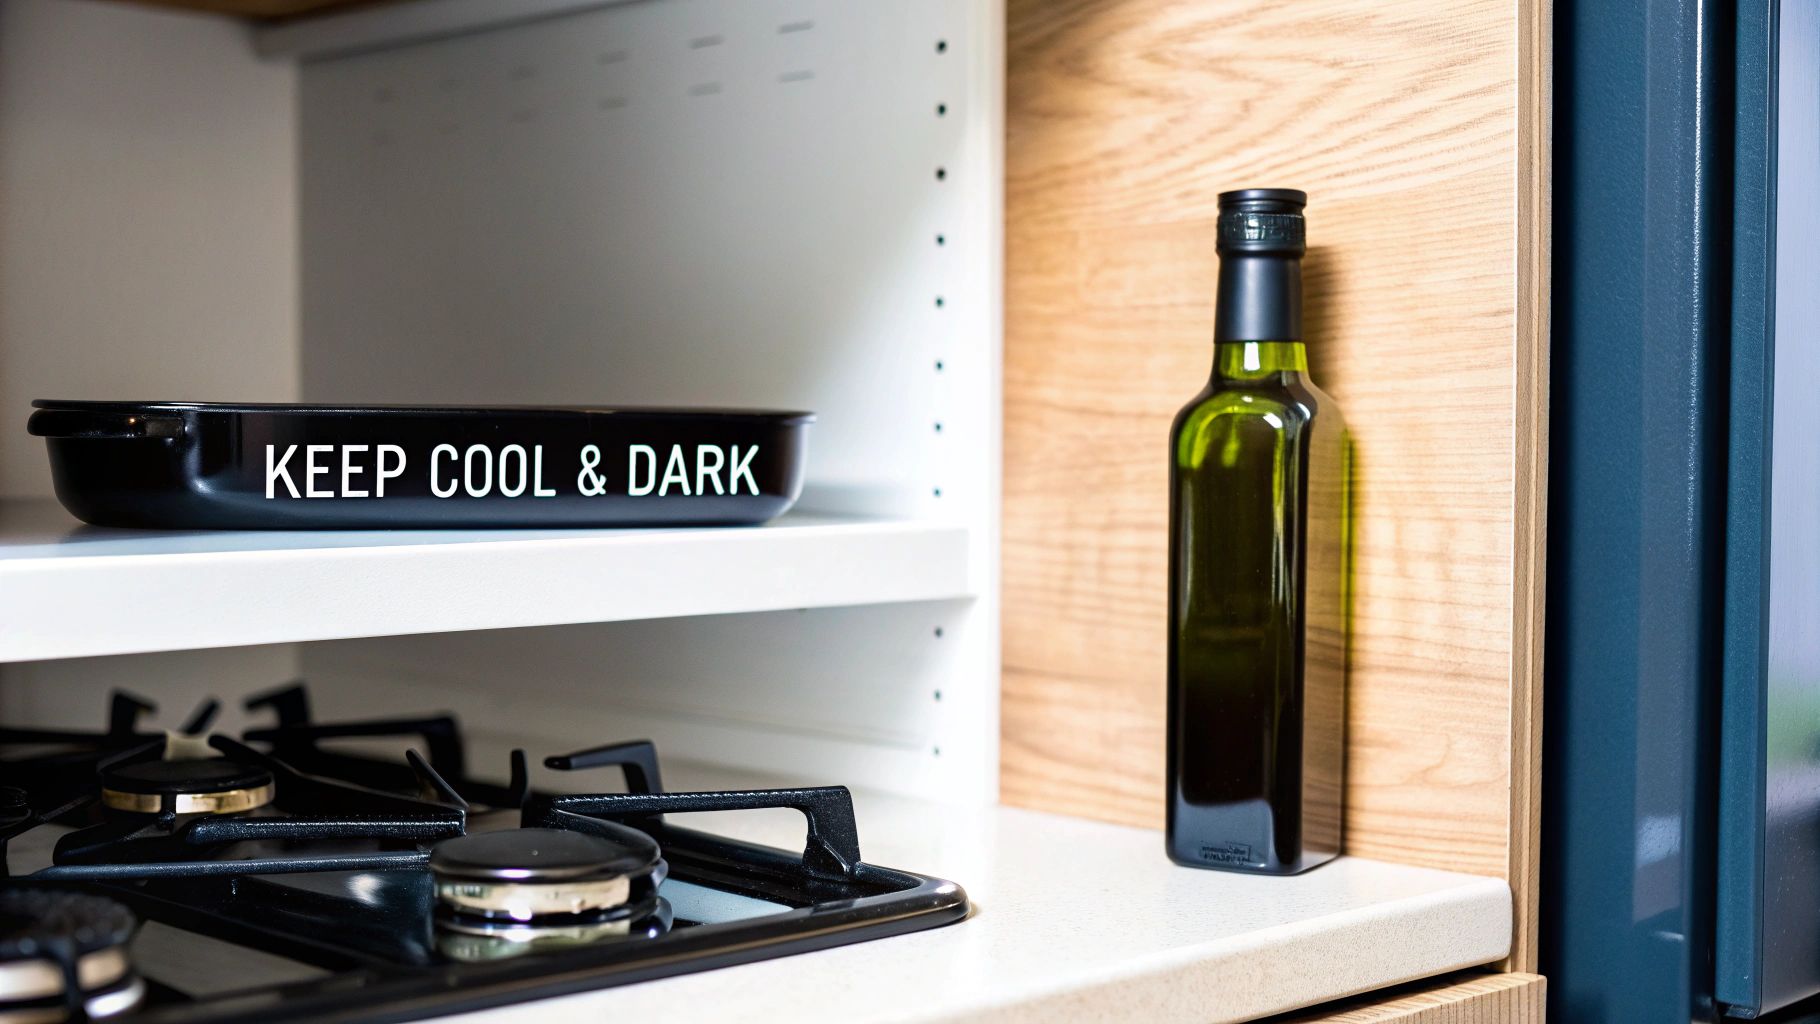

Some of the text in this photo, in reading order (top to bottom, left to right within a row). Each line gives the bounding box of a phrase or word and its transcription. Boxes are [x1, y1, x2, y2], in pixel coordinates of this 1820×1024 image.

[265, 443, 760, 499] KEEP COOL & DARK
